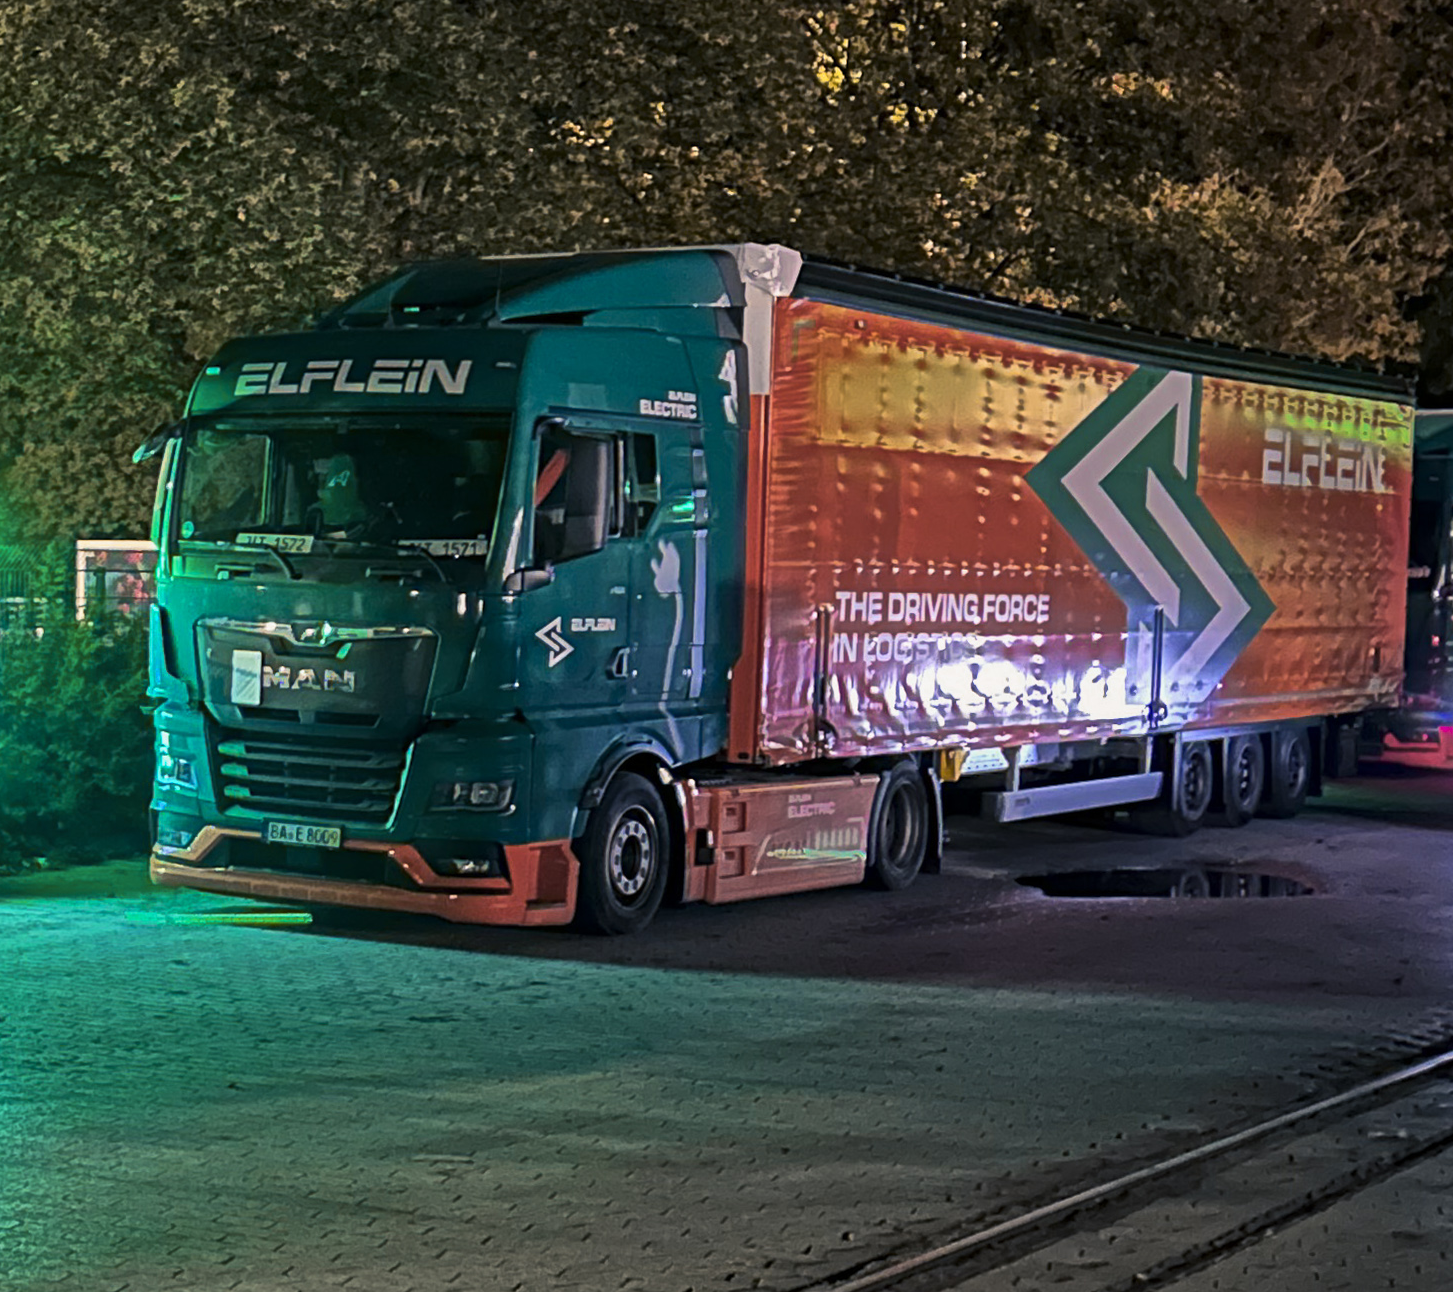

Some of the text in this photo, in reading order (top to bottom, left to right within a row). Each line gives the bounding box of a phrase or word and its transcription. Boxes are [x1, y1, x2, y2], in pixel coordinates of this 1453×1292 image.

[639, 398, 697, 419] ELECTRIC
[275, 536, 306, 552] 1572
[442, 541, 477, 556] 1571
[835, 591, 1051, 623] THE DRIVING FORCE
[832, 632, 858, 663] IN
[263, 665, 355, 693] MAN
[270, 824, 287, 840] BA
[295, 826, 304, 842] E
